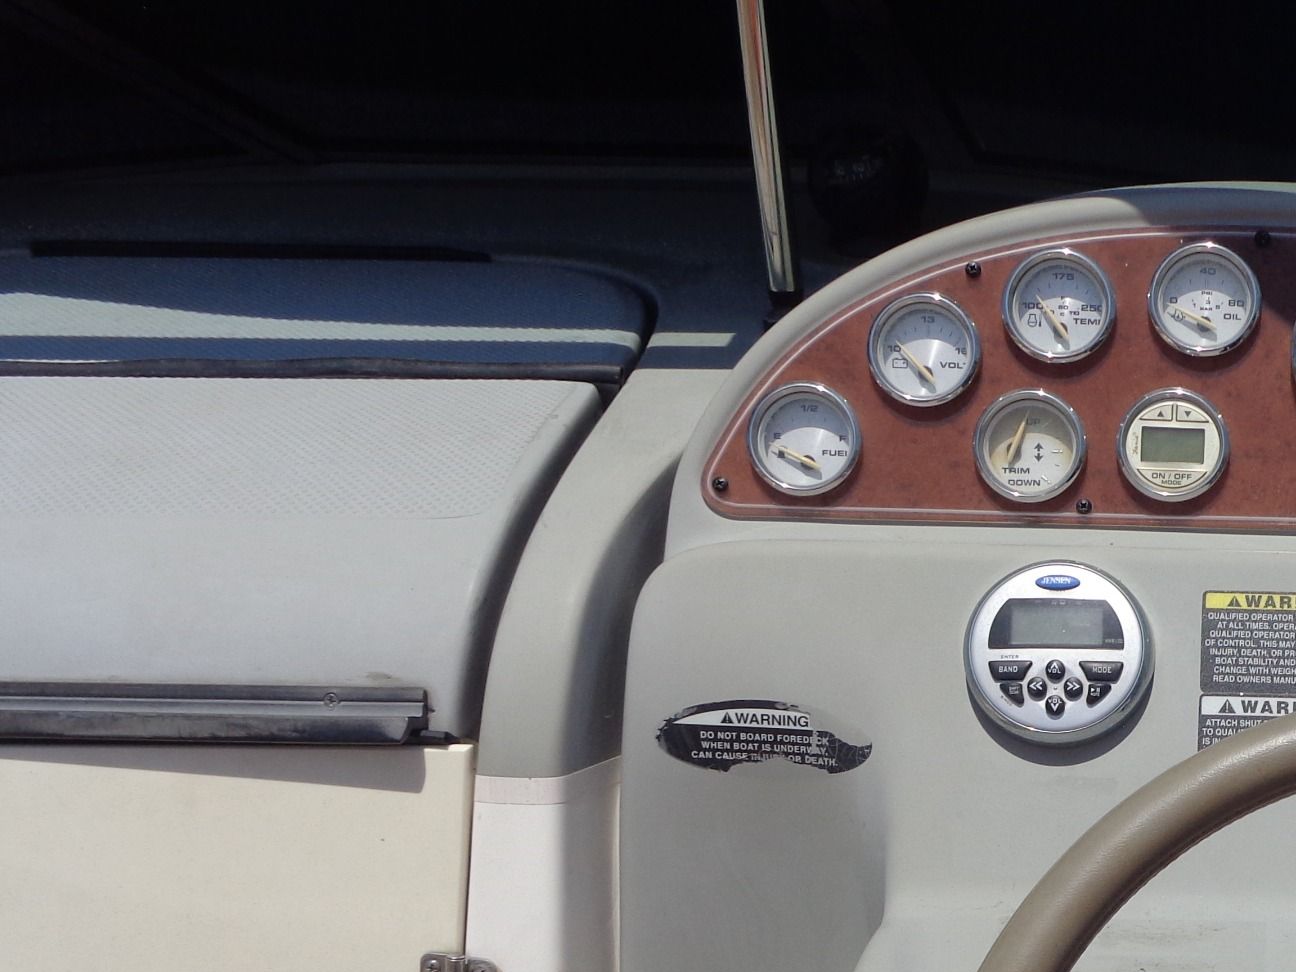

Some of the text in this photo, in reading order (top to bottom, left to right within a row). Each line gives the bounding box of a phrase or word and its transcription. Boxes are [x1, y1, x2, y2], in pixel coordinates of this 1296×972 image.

[1223, 313, 1242, 321] OIL
[940, 361, 966, 369] VOL
[1002, 467, 1030, 475] TRIM
[1151, 472, 1192, 481] ON OFF
[1008, 479, 1041, 487] DOWN
[1041, 577, 1072, 585] JENSEN
[1208, 612, 1249, 620] QUALIFIED
[1250, 613, 1294, 621] OPERATOR
[1217, 621, 1227, 629] AT
[1245, 622, 1271, 630] TIMES.
[1209, 630, 1251, 638] QUALIFIED
[1252, 631, 1296, 639] OPERATOR
[1205, 639, 1216, 647] OF
[1217, 639, 1258, 647] CONTROL.
[1260, 640, 1278, 648] THIS
[1209, 648, 1239, 657] INJURY,
[1271, 649, 1283, 657] OR
[1215, 657, 1237, 665] BOAT
[1238, 658, 1278, 666] STABILITY
[1279, 658, 1296, 666] AND
[998, 665, 1019, 673] BAND
[1213, 666, 1248, 674] CHANGE
[1249, 666, 1269, 674] WITH
[1212, 674, 1235, 682] READ
[1236, 675, 1272, 683] OWNERS
[735, 712, 809, 728] WARNING
[1205, 719, 1238, 727] ATTACH
[700, 730, 829, 745] DO NOT BOARD FOREDECK
[1202, 737, 1210, 745] IS
[701, 741, 731, 750] WHEN
[733, 742, 759, 751] BOAT
[761, 743, 771, 751] IS
[691, 750, 839, 767] CAN CAUSE OR DEATH.
